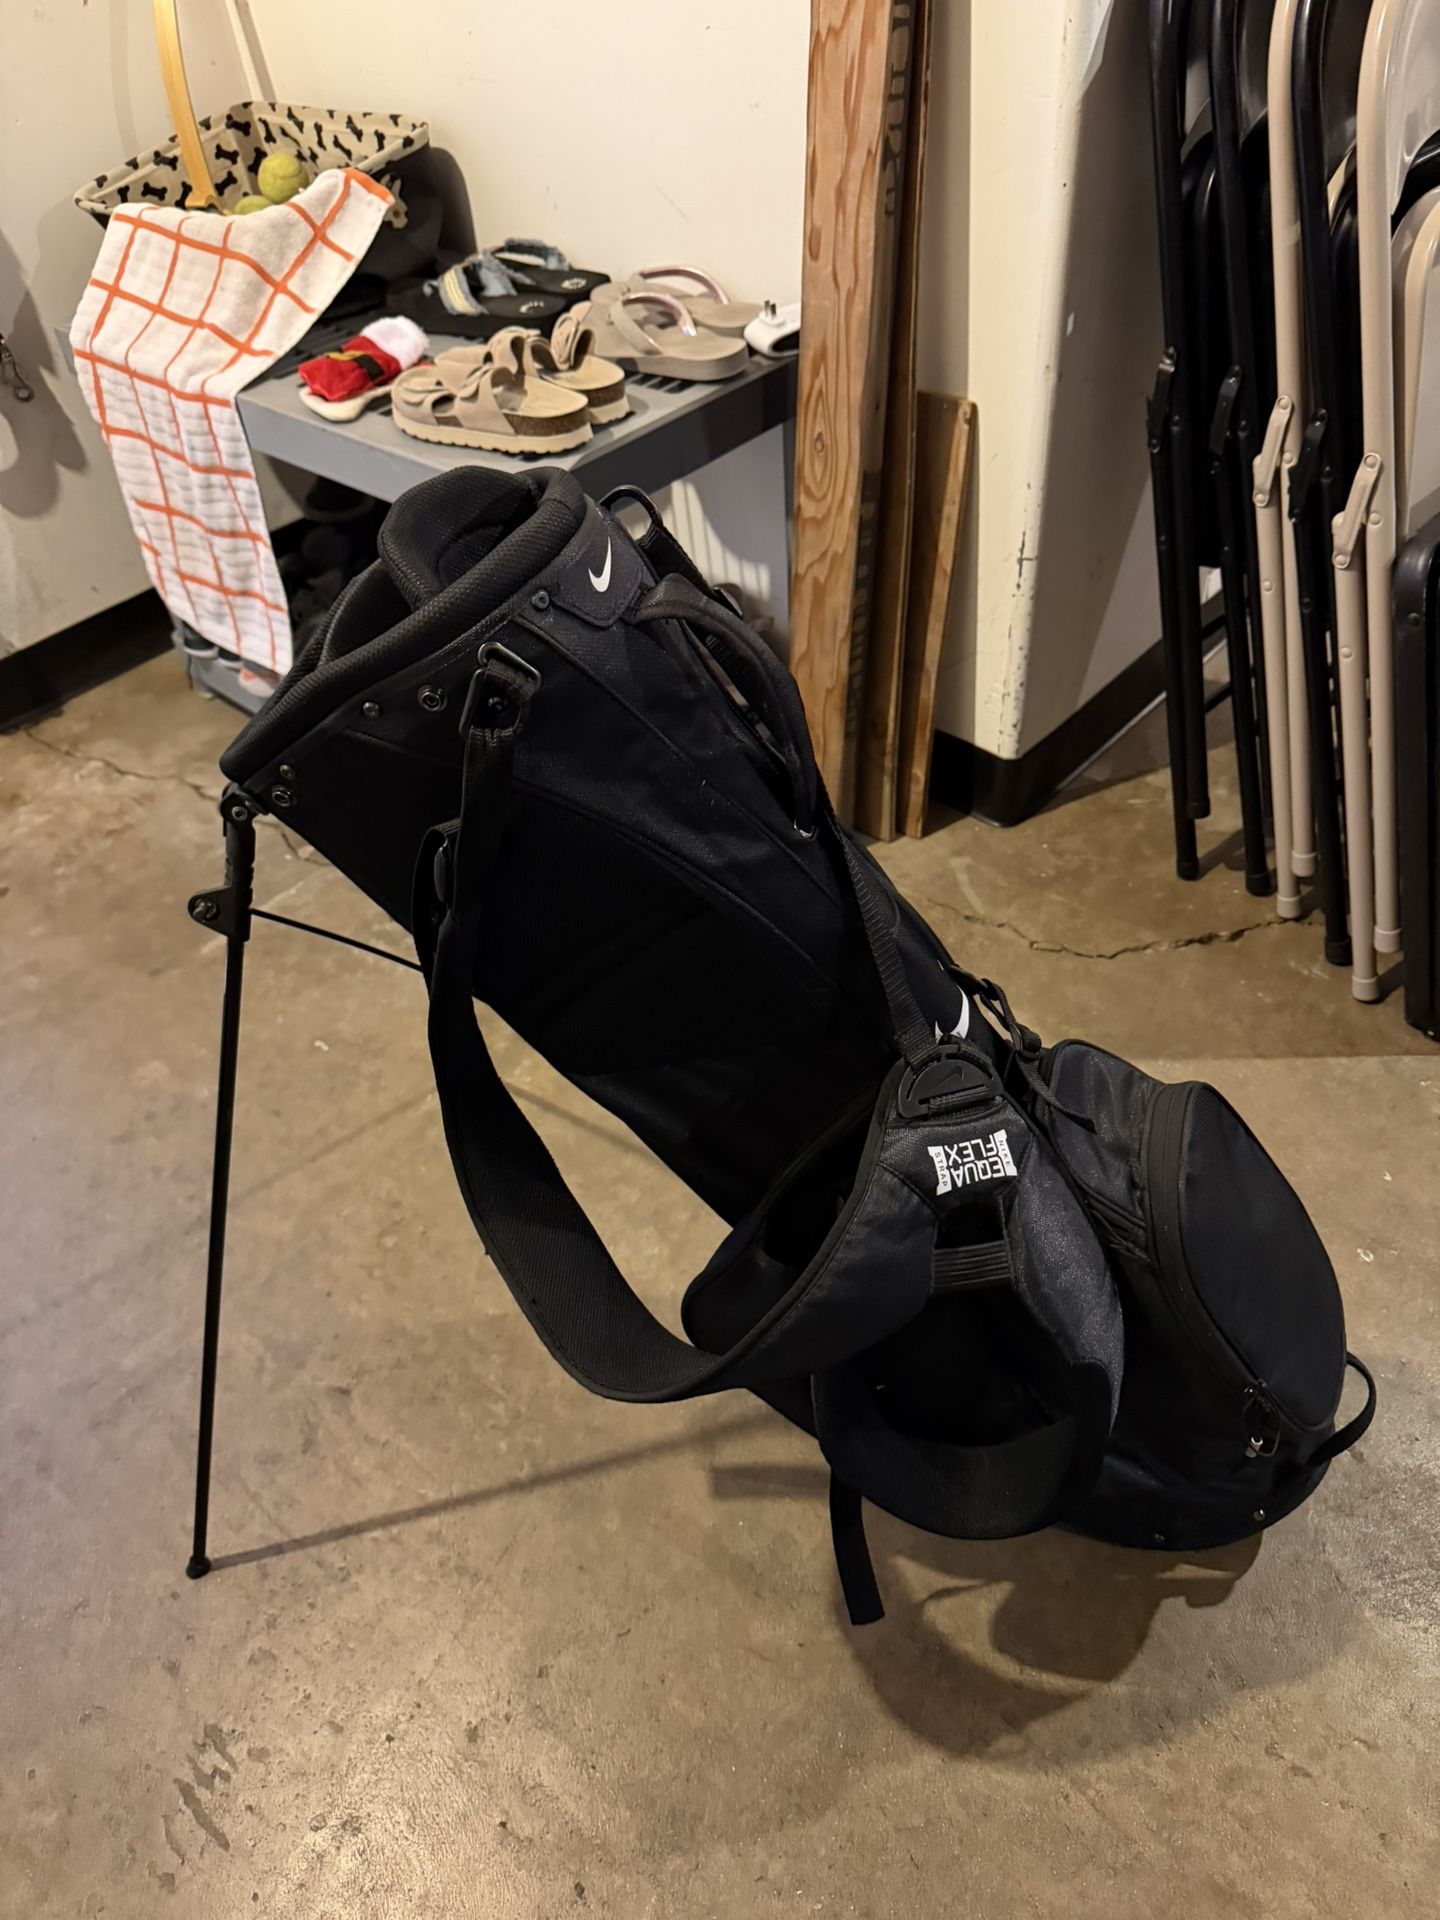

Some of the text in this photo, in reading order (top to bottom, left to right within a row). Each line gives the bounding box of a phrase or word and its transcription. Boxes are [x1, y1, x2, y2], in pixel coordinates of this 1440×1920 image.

[944, 1134, 998, 1166] FLEX
[998, 1140, 1011, 1167] NIKE
[934, 1151, 948, 1187] STRAP
[950, 1156, 1005, 1188] EQUA
